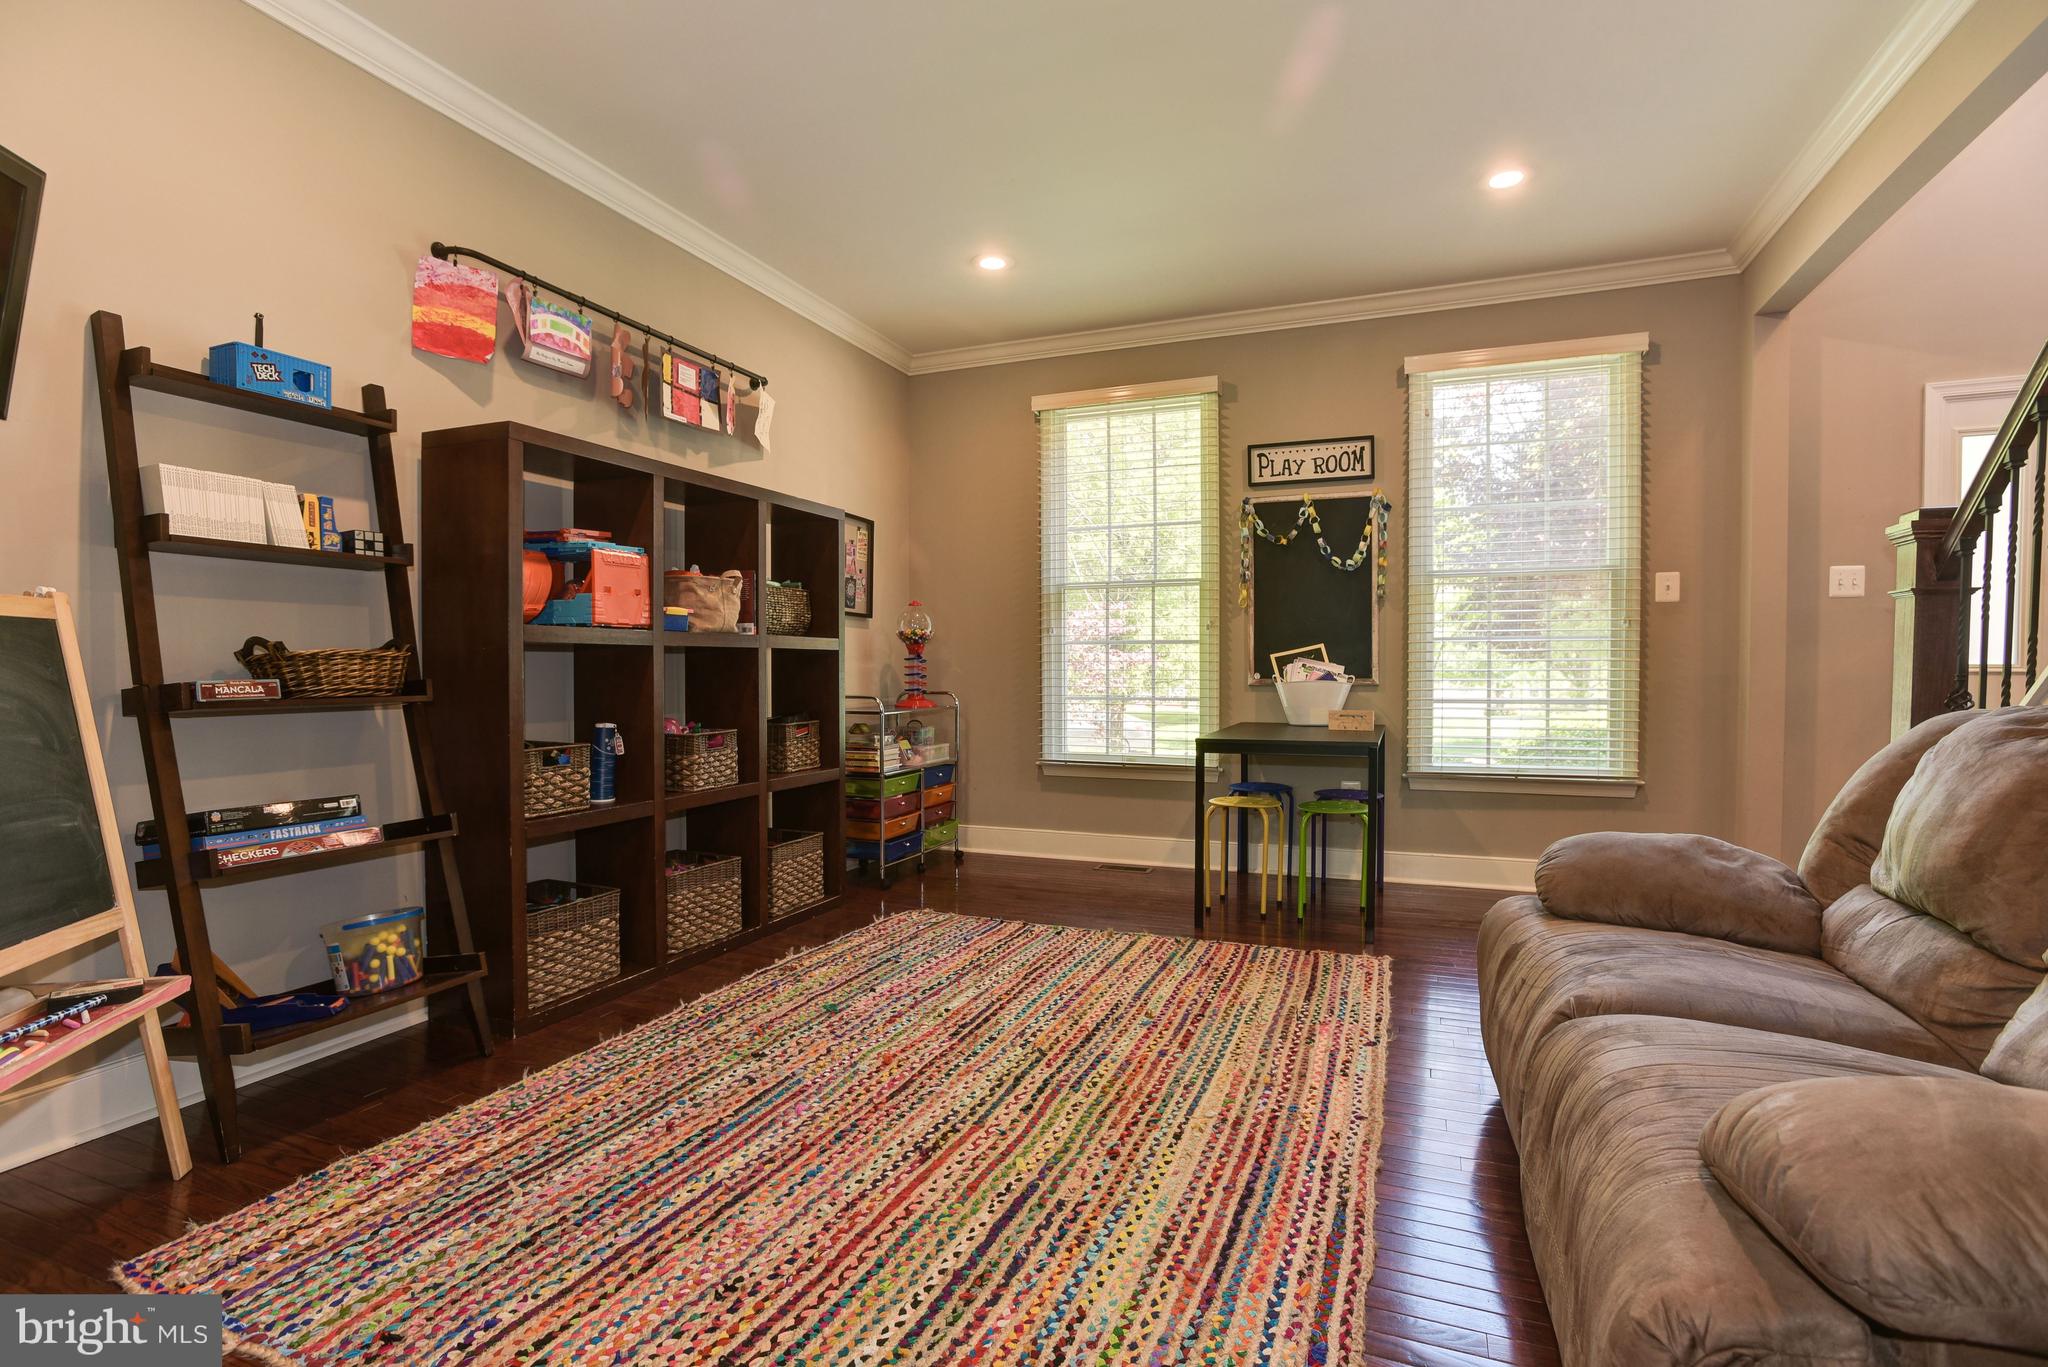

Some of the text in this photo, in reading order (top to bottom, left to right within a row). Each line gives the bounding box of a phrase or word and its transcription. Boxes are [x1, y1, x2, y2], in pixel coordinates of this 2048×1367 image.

[252, 363, 275, 373] TECH
[256, 371, 280, 381] DECK
[1256, 446, 1365, 478] PLAY ROOM
[214, 685, 265, 694] MANCALA
[270, 823, 321, 840] FASTRACK
